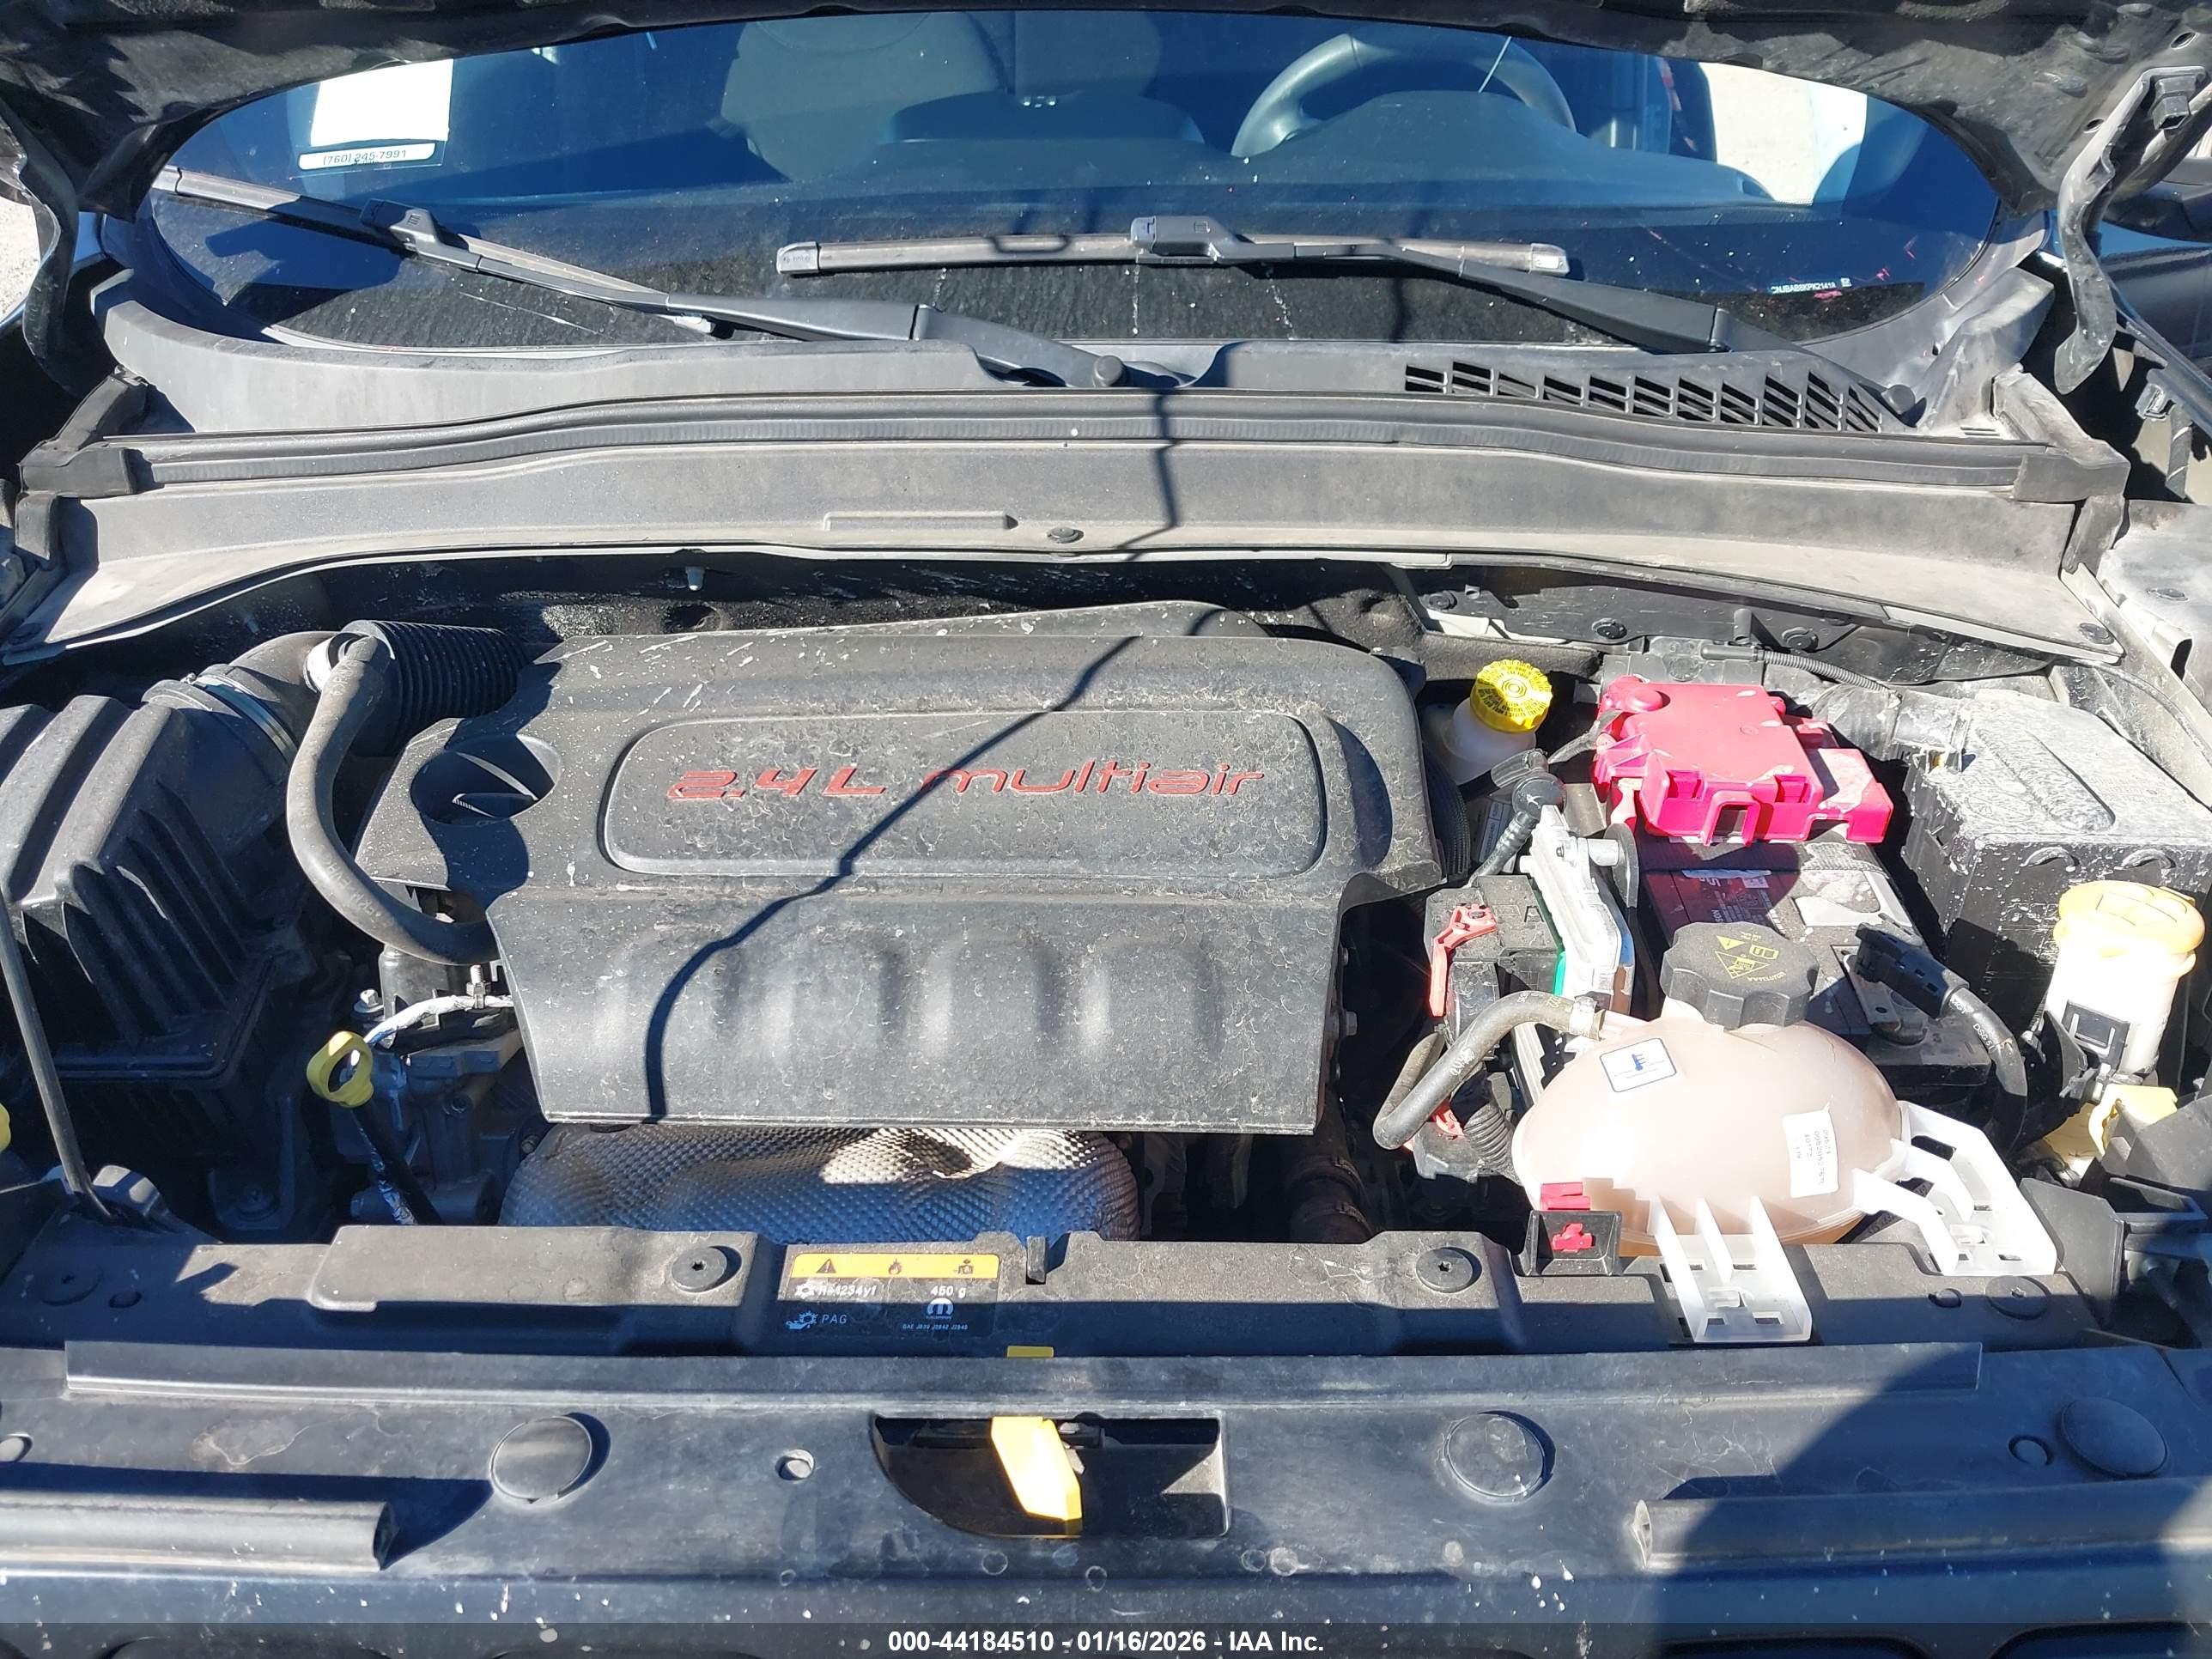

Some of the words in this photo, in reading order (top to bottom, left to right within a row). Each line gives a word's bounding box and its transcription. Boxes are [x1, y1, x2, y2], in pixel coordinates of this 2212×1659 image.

[323, 154, 351, 166] (760)
[355, 150, 406, 163] 245-7991
[921, 761, 1263, 796] multiair
[930, 1285, 954, 1297] 450
[958, 1287, 967, 1299] g
[822, 1314, 848, 1324] PAG
